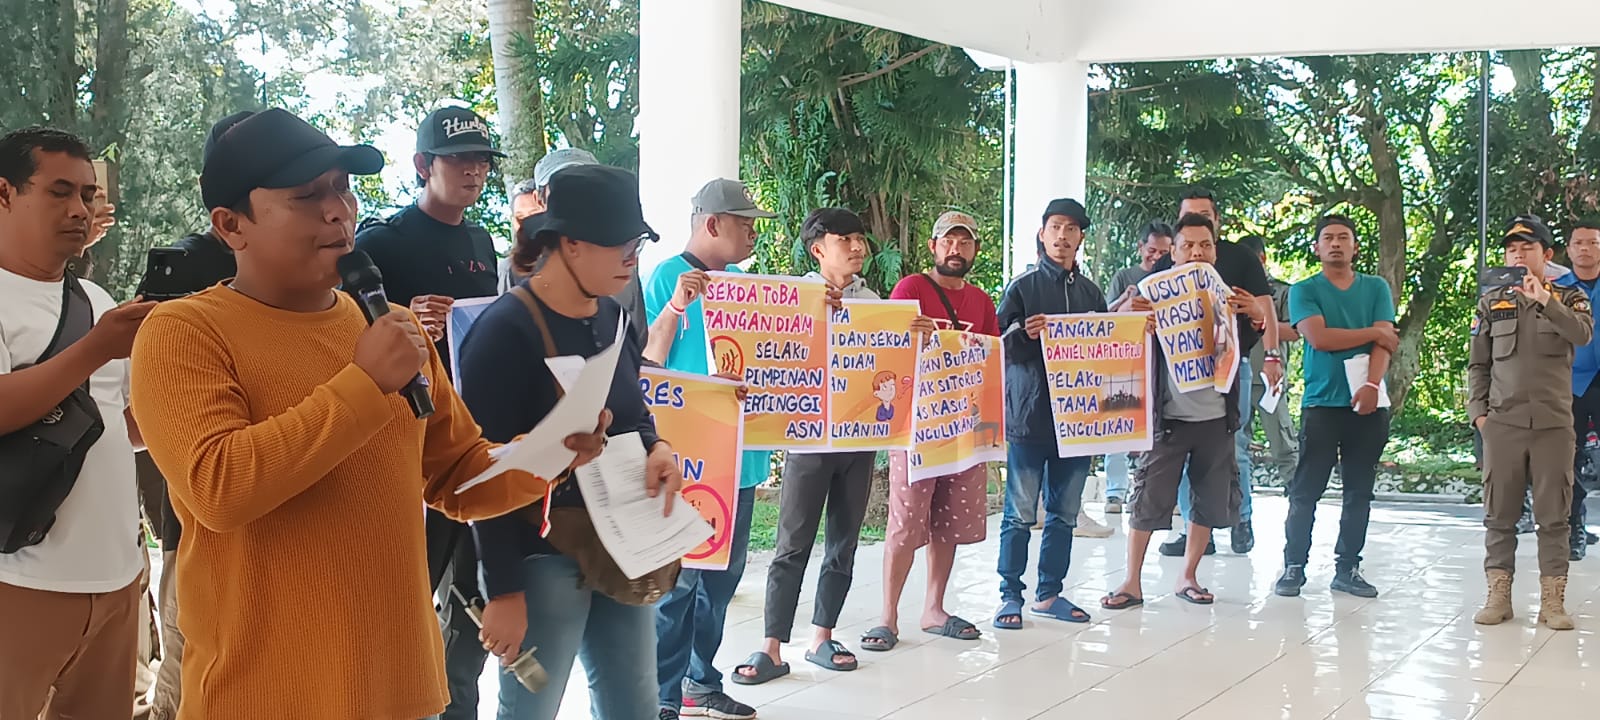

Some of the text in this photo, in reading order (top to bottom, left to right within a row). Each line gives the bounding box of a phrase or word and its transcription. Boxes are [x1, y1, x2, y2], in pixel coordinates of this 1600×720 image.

[706, 282, 758, 303] SEKDA
[1147, 274, 1188, 303] USUT
[1156, 298, 1205, 329] KASUS
[776, 315, 813, 335] DIAM
[1046, 320, 1115, 339] TANGKAP
[838, 331, 867, 347] DAN
[870, 331, 911, 347] SEKDA
[1164, 327, 1204, 355] YANG
[842, 353, 875, 370] DIAM
[1046, 343, 1085, 361] DANIEL
[745, 367, 823, 387] PIMPINAN
[930, 396, 968, 416] KASUS
[786, 421, 823, 438] ASN
[872, 423, 889, 436] INI
